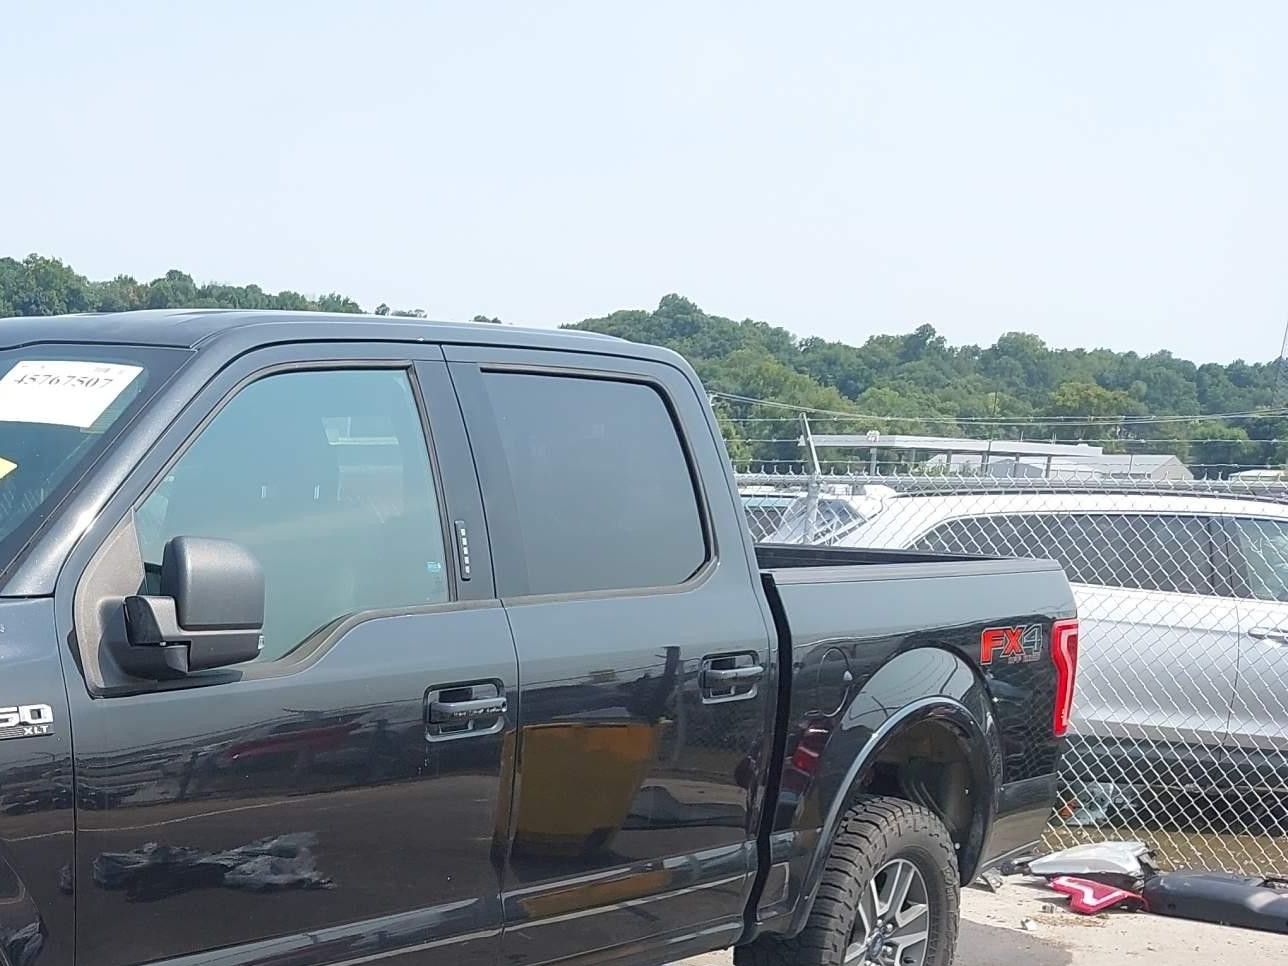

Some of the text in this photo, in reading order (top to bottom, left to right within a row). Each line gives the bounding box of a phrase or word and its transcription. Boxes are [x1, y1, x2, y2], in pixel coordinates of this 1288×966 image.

[14, 374, 113, 389] 45767507
[980, 623, 1043, 666] FX4
[23, 725, 49, 736] XLT
